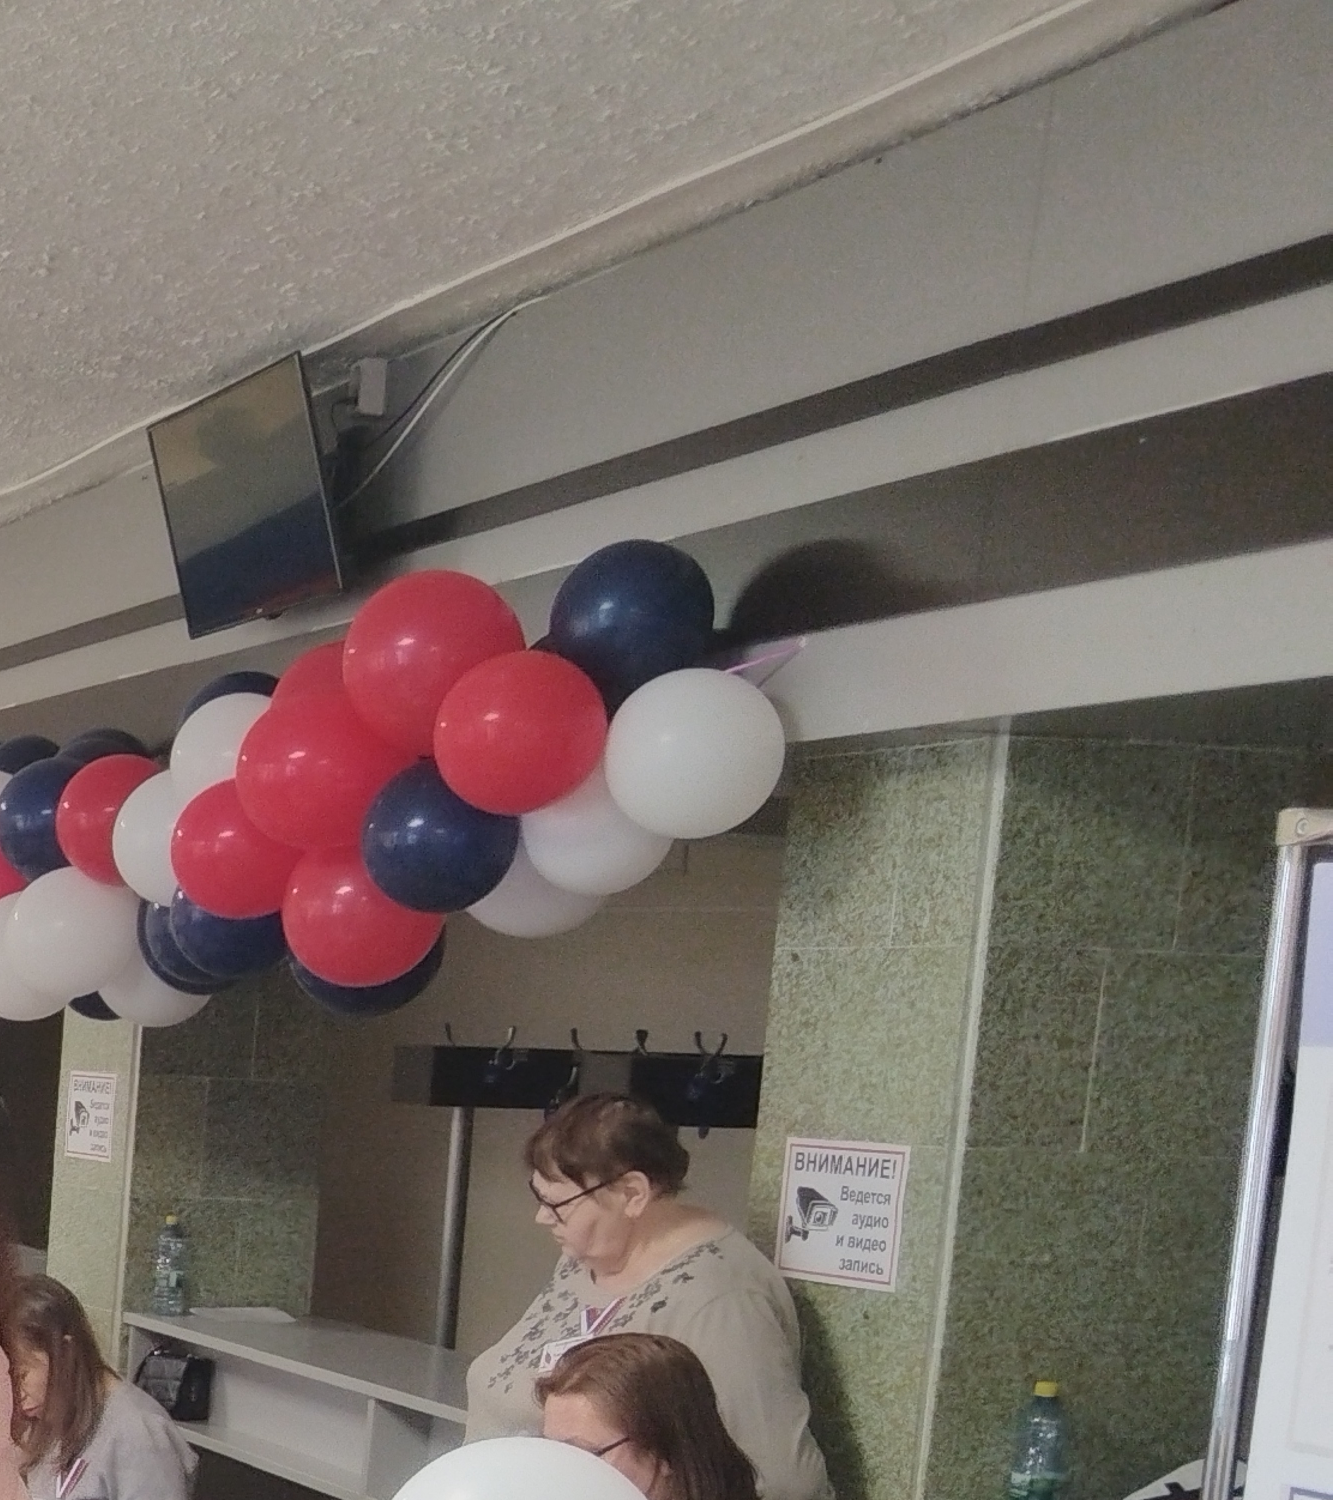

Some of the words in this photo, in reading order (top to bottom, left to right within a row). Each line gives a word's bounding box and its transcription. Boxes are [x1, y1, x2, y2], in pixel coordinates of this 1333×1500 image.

[794, 1152, 897, 1179] ВНИМАНИЕ!
[840, 1186, 891, 1205] Ведется
[851, 1213, 889, 1230] аудио
[835, 1235, 844, 1247] и
[847, 1236, 887, 1252] видео
[839, 1258, 884, 1275] запись
